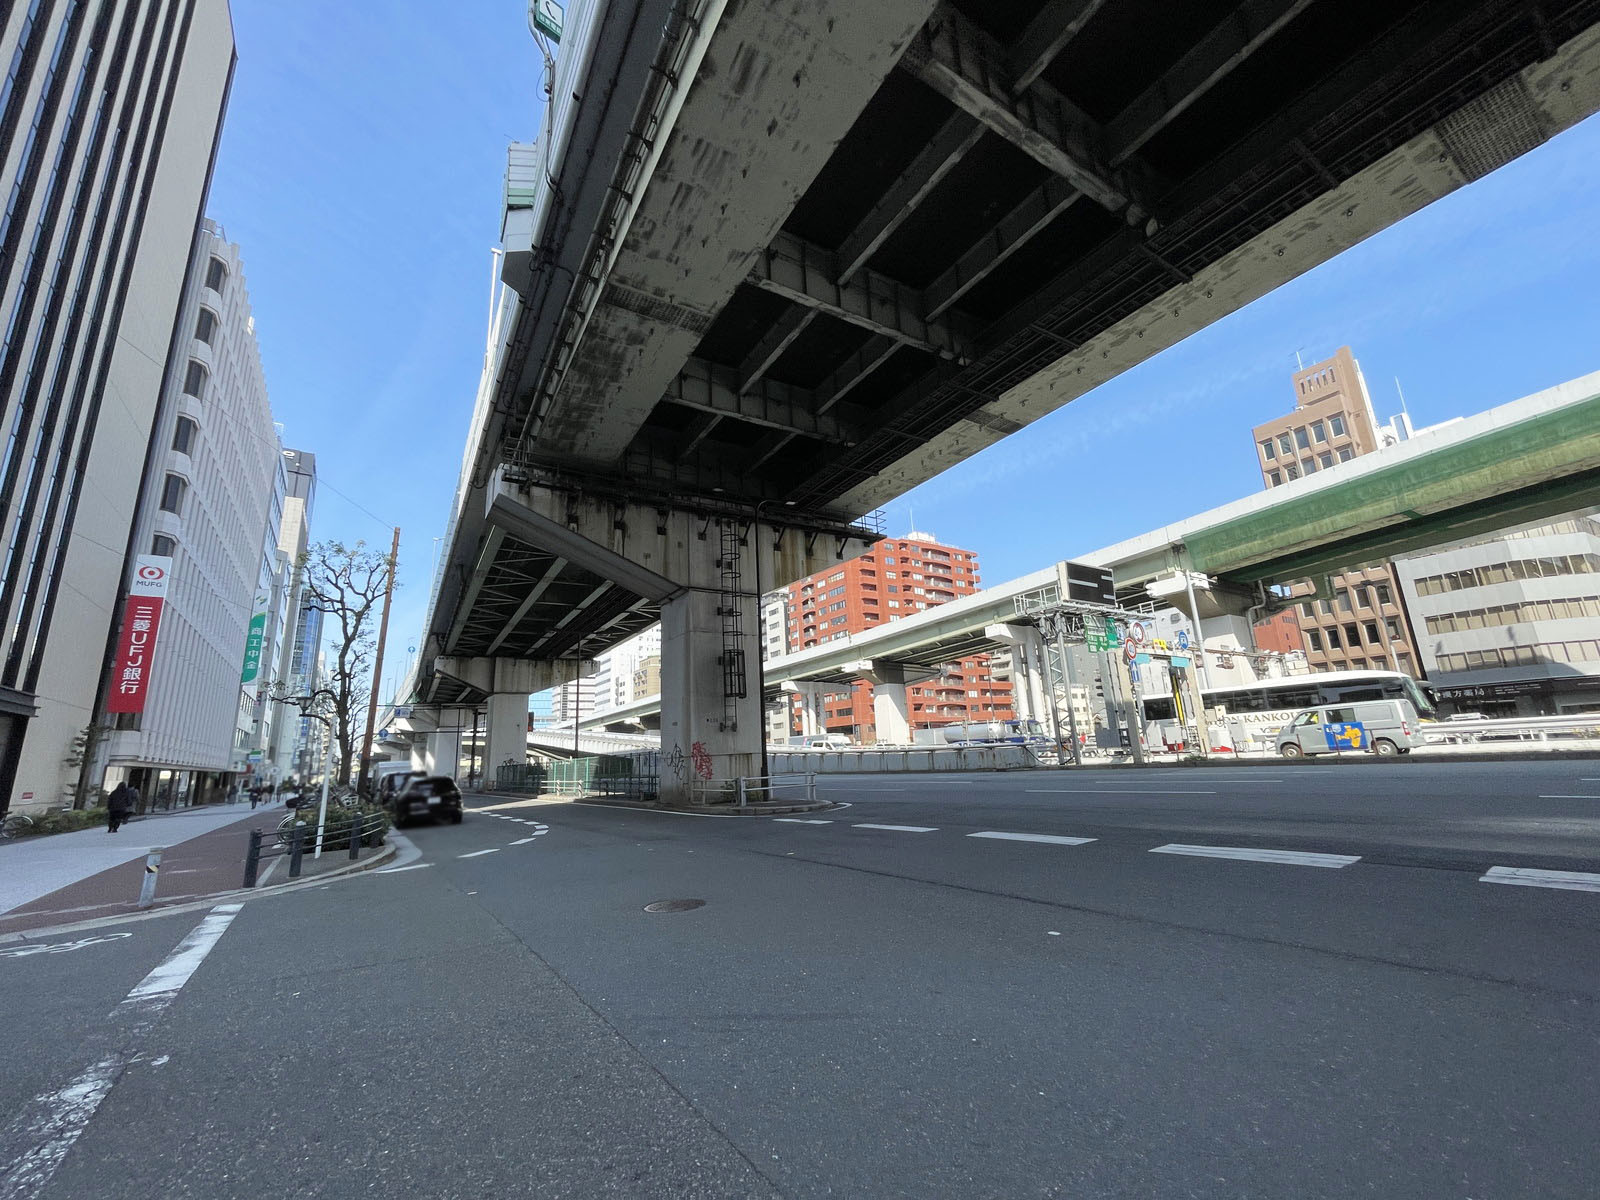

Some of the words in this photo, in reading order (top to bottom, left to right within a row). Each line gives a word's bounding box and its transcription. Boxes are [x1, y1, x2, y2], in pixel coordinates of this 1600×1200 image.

[136, 580, 163, 588] MUFG
[120, 605, 153, 694] 三菱UFJ銀行
[246, 627, 262, 670] 商工中金
